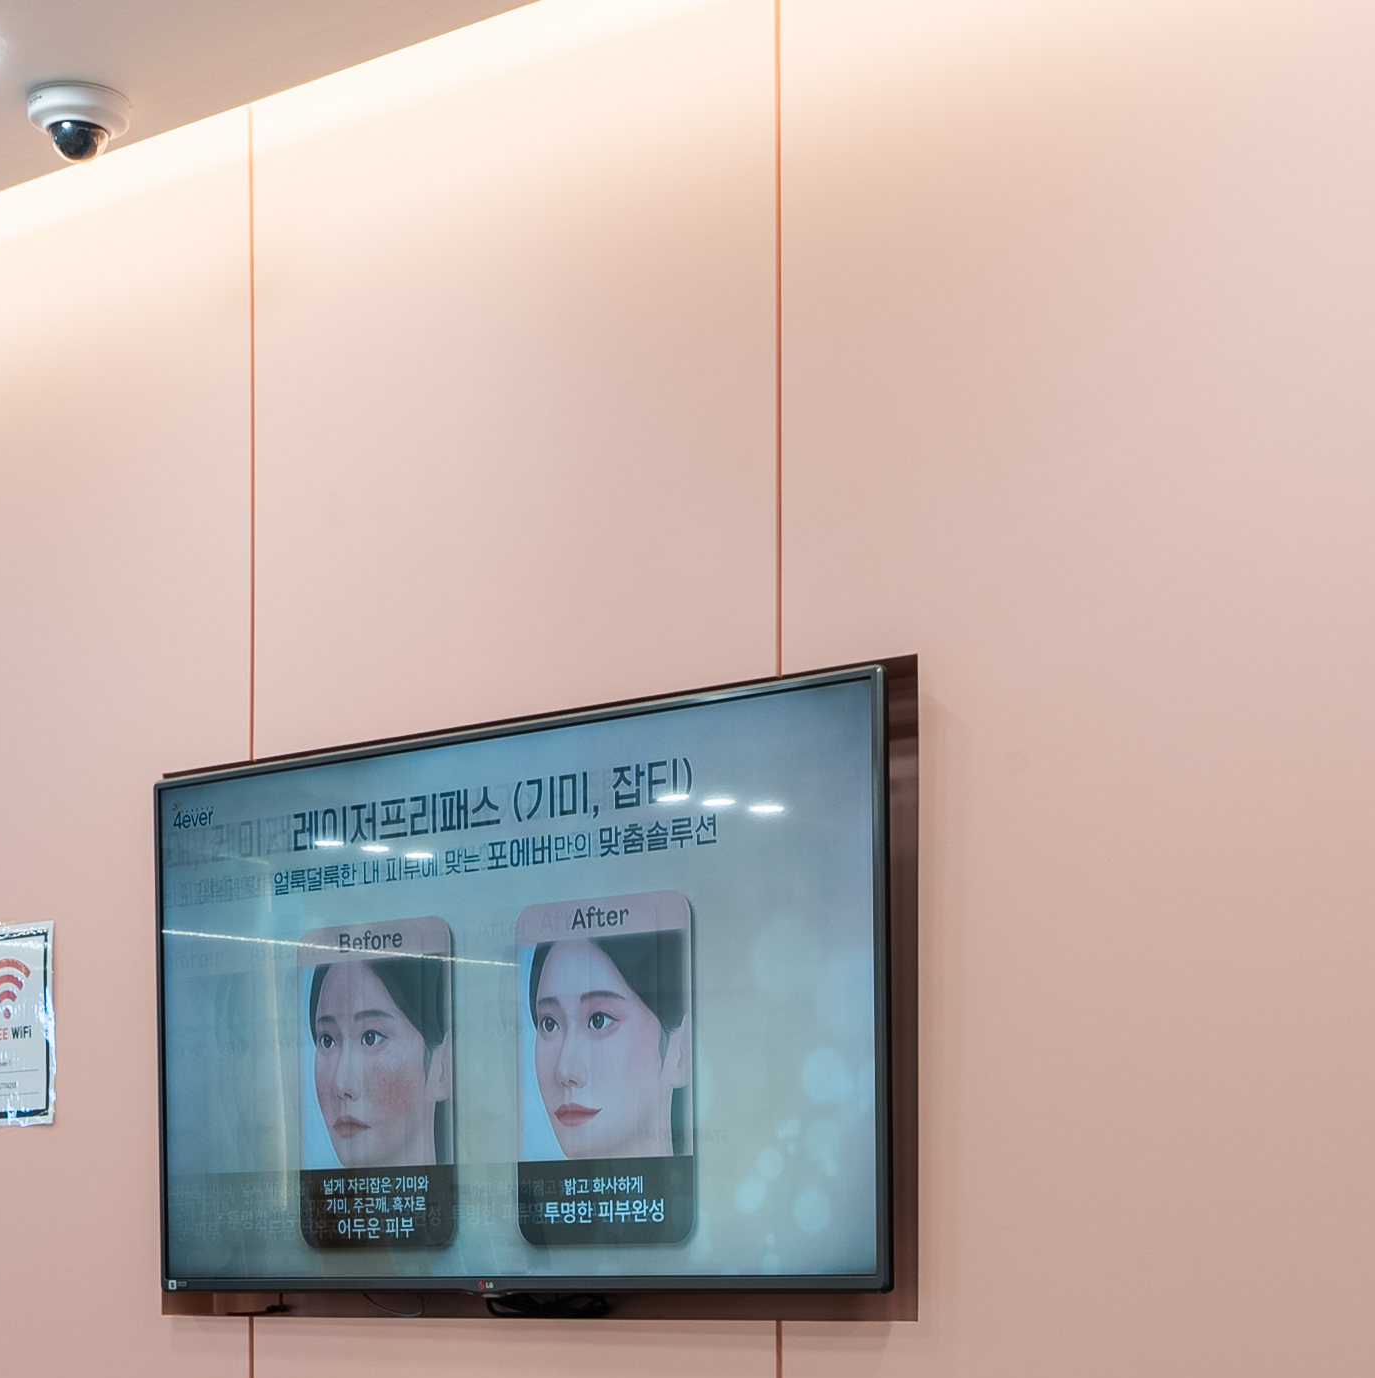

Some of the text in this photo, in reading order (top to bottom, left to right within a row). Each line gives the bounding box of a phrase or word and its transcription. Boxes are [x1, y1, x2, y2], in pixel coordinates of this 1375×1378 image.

[293, 757, 693, 852] 레이저프리패스 (기미, 잡티)
[172, 809, 214, 829] 4ever
[274, 812, 718, 896] 얼룩덜룩한 내 피부에 맞는 포에버만의 맞춤솔루션
[571, 906, 630, 930] After
[338, 931, 403, 954] Before
[11, 1025, 32, 1040] WiFi
[324, 1175, 429, 1195] 넓게 자리잡은 기미와
[564, 1175, 643, 1196] 밝고 화사하게
[326, 1198, 351, 1214] 기미,
[353, 1197, 390, 1214] 주근깨,
[544, 1198, 665, 1224] 투명한 피부완성
[337, 1217, 415, 1239] 어두운 피부
